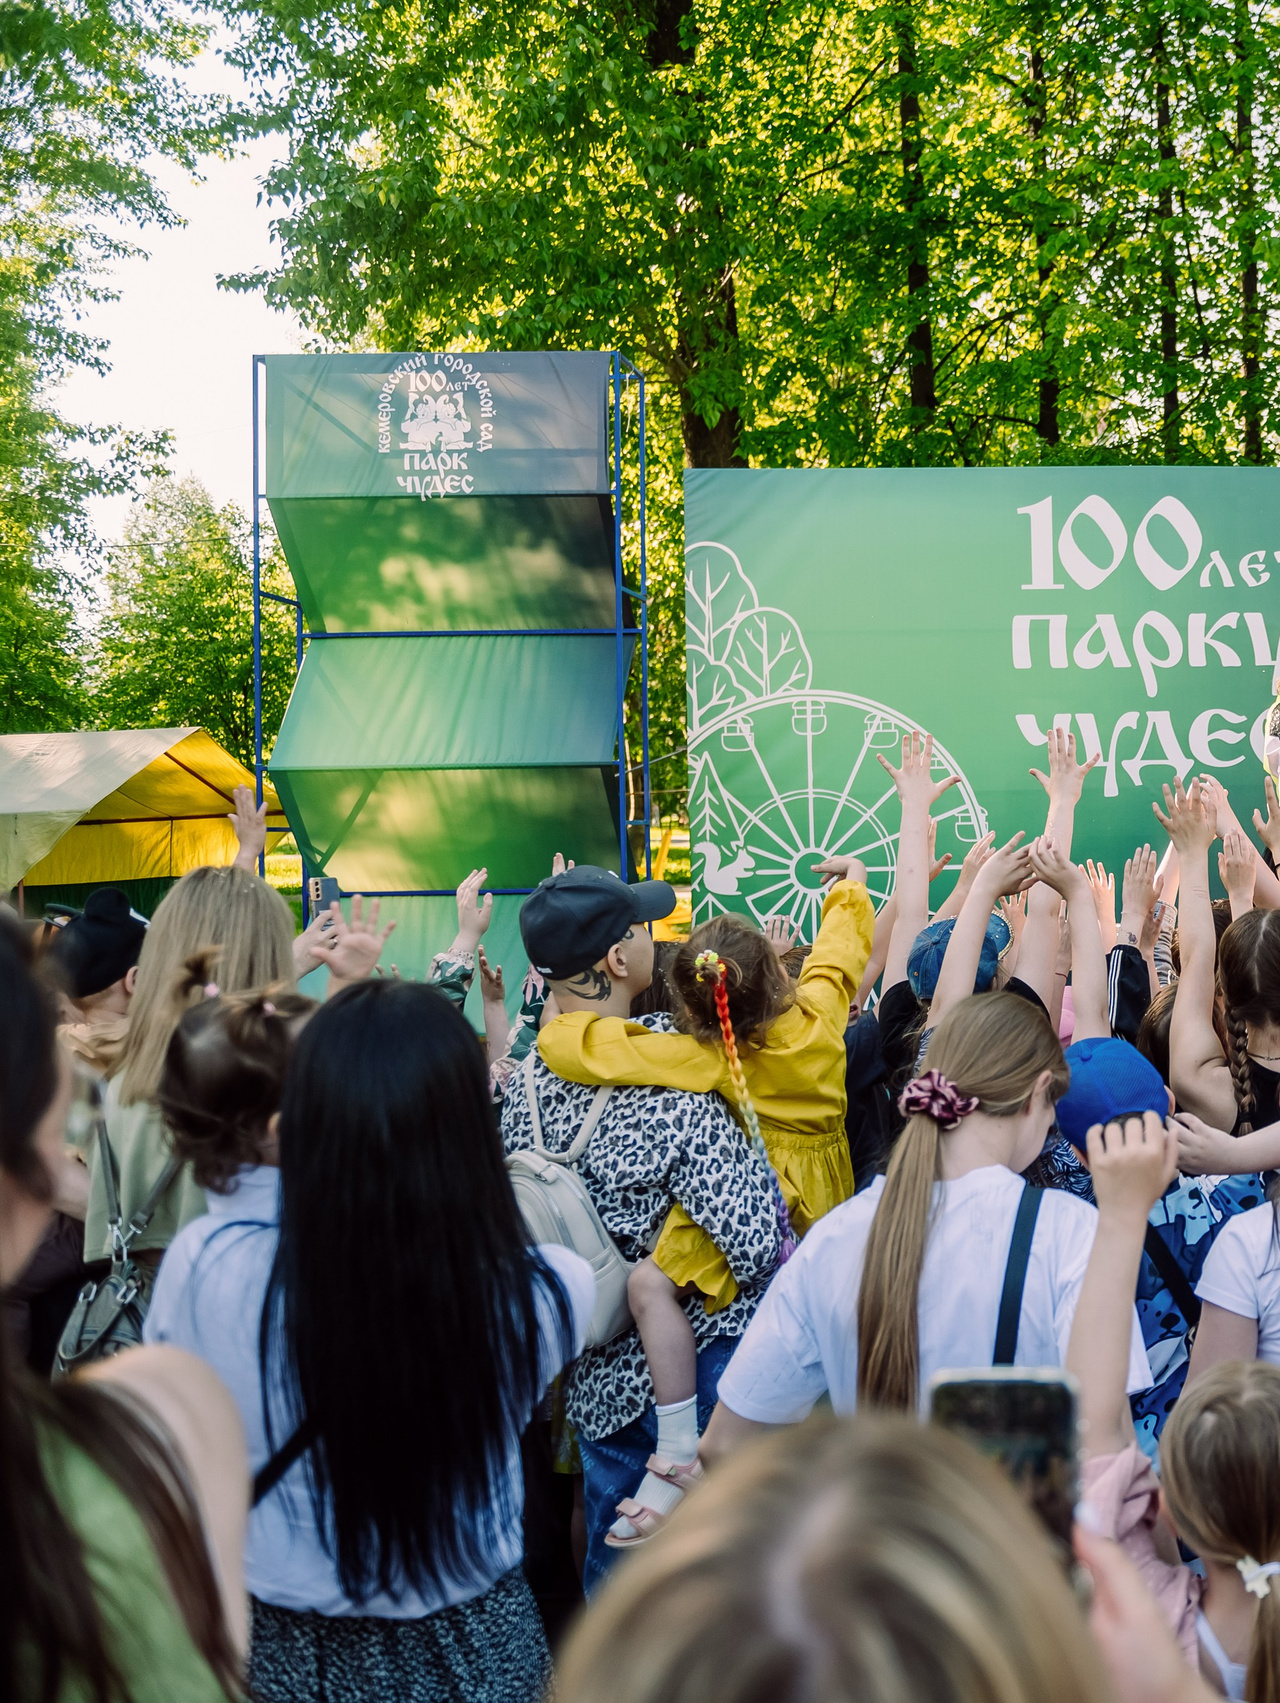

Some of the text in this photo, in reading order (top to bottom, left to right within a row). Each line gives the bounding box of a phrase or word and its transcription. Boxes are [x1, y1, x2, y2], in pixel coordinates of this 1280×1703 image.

[407, 369, 470, 392] 100 ЛЕТ
[377, 352, 497, 454] КЕМЕРОВСКИЙ ГОРОДСКОЙ САД
[403, 452, 468, 479] ПАРК
[396, 474, 475, 502] ЧУДЕС
[1016, 494, 1203, 591] 100
